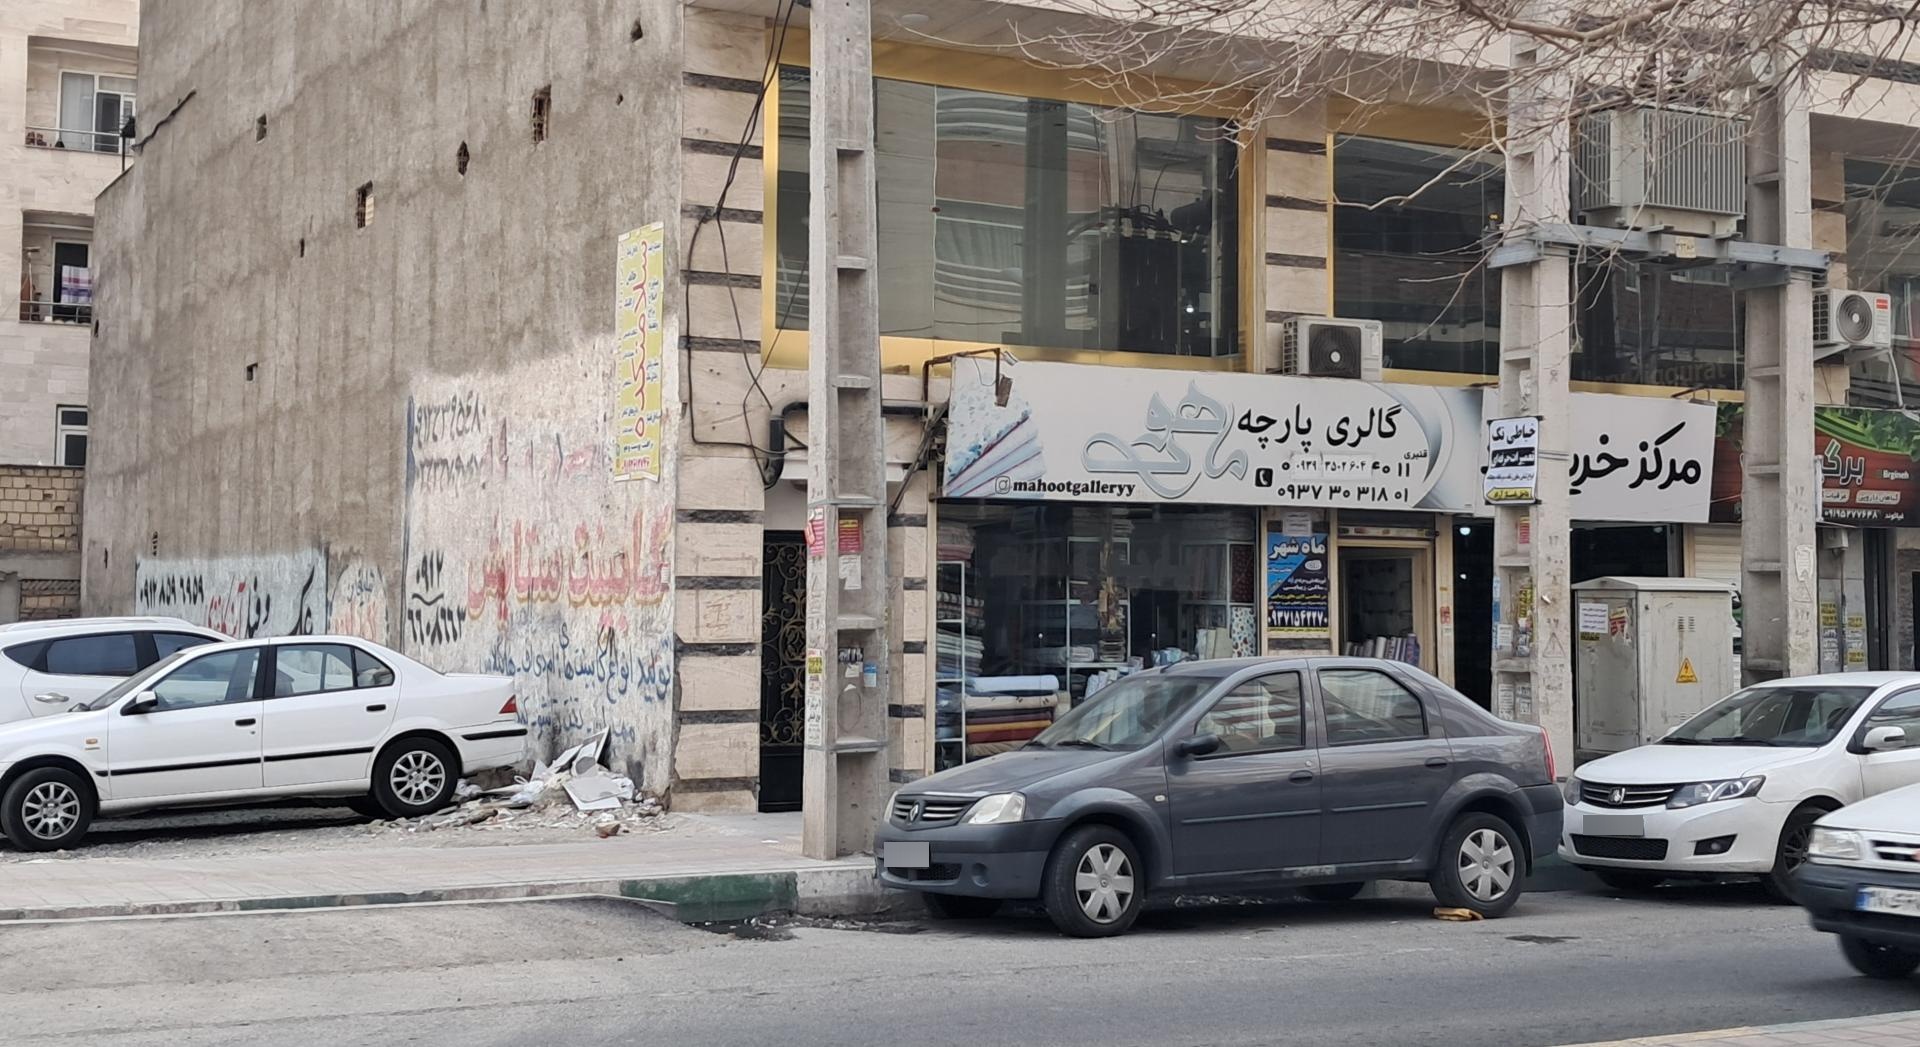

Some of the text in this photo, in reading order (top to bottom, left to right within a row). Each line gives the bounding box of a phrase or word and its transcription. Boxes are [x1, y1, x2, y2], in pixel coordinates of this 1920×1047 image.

[1237, 403, 1402, 453] گالری پارچه
[1507, 423, 1536, 444] خیاطی
[1569, 421, 1701, 496] مرکز خری
[1822, 439, 1865, 486] برگ
[1012, 479, 1136, 497] mahootgalleryy
[1277, 484, 1409, 502] ۰۹۳۷ ۳۰ ۳۱۸ ۰۱
[1268, 537, 1326, 559] ماه شهر
[415, 549, 445, 593] ۰۹۱۲
[638, 638, 672, 701] تولید
